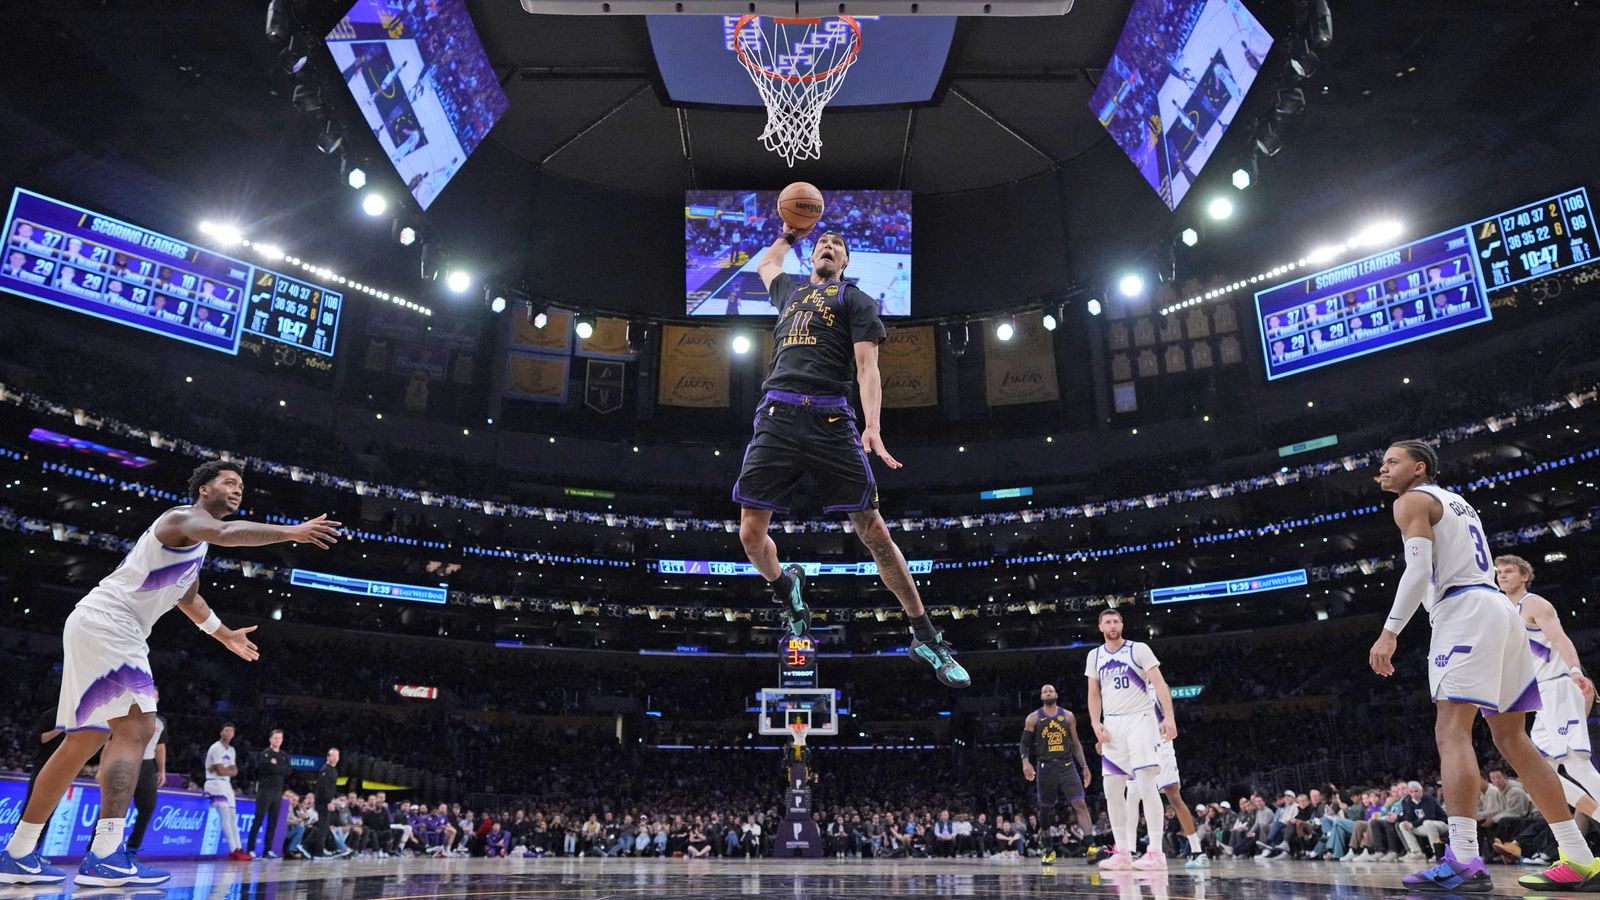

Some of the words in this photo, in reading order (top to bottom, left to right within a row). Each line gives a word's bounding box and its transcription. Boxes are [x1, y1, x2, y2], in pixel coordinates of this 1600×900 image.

[1503, 217, 1514, 232] 27
[1517, 212, 1530, 227] 40
[1531, 207, 1543, 222] 37
[1549, 203, 1558, 218] 2
[1564, 194, 1584, 212] 106
[1536, 226, 1551, 241] 22
[1554, 222, 1562, 236] 6
[1571, 214, 1587, 230] 99
[41, 232, 62, 247] 37
[91, 217, 142, 244] SCORING
[141, 234, 188, 259] LEADERS
[90, 247, 108, 262] 21
[1520, 244, 1558, 271] 10:47
[33, 259, 54, 277] 29
[139, 262, 152, 276] 11
[1315, 265, 1358, 290] SCORING
[1359, 251, 1401, 280] LEADERS
[1453, 260, 1462, 274] 7
[82, 273, 103, 291] 29
[182, 275, 195, 289] 10
[1407, 273, 1420, 288] 10
[131, 288, 147, 303] 13
[225, 288, 235, 301] 7
[278, 280, 289, 293] 27
[288, 284, 300, 297] 40
[299, 287, 311, 300] 37
[312, 291, 320, 304] 2
[324, 295, 339, 310] 106
[1367, 286, 1377, 301] 11
[1459, 286, 1468, 302] 7
[177, 301, 188, 315] 9
[296, 304, 308, 318] 22
[309, 307, 317, 320] 6
[802, 290, 834, 327] ANGELES
[1326, 297, 1338, 314] 21
[1415, 299, 1424, 315] 9
[220, 313, 230, 327] 7
[788, 311, 813, 336] 11
[1287, 310, 1300, 325] 37
[1371, 311, 1383, 327] 13
[277, 317, 308, 338] 10:47
[1329, 323, 1344, 340] 29
[783, 335, 816, 347] LAKERS
[1291, 334, 1305, 350] 29
[1449, 501, 1478, 523] GEG
[1469, 524, 1489, 573] 3
[713, 563, 732, 573] 106
[1114, 676, 1130, 690] 30
[1047, 732, 1062, 745] 23
[290, 759, 314, 767] ULTRA
[153, 806, 205, 831] Michelob
